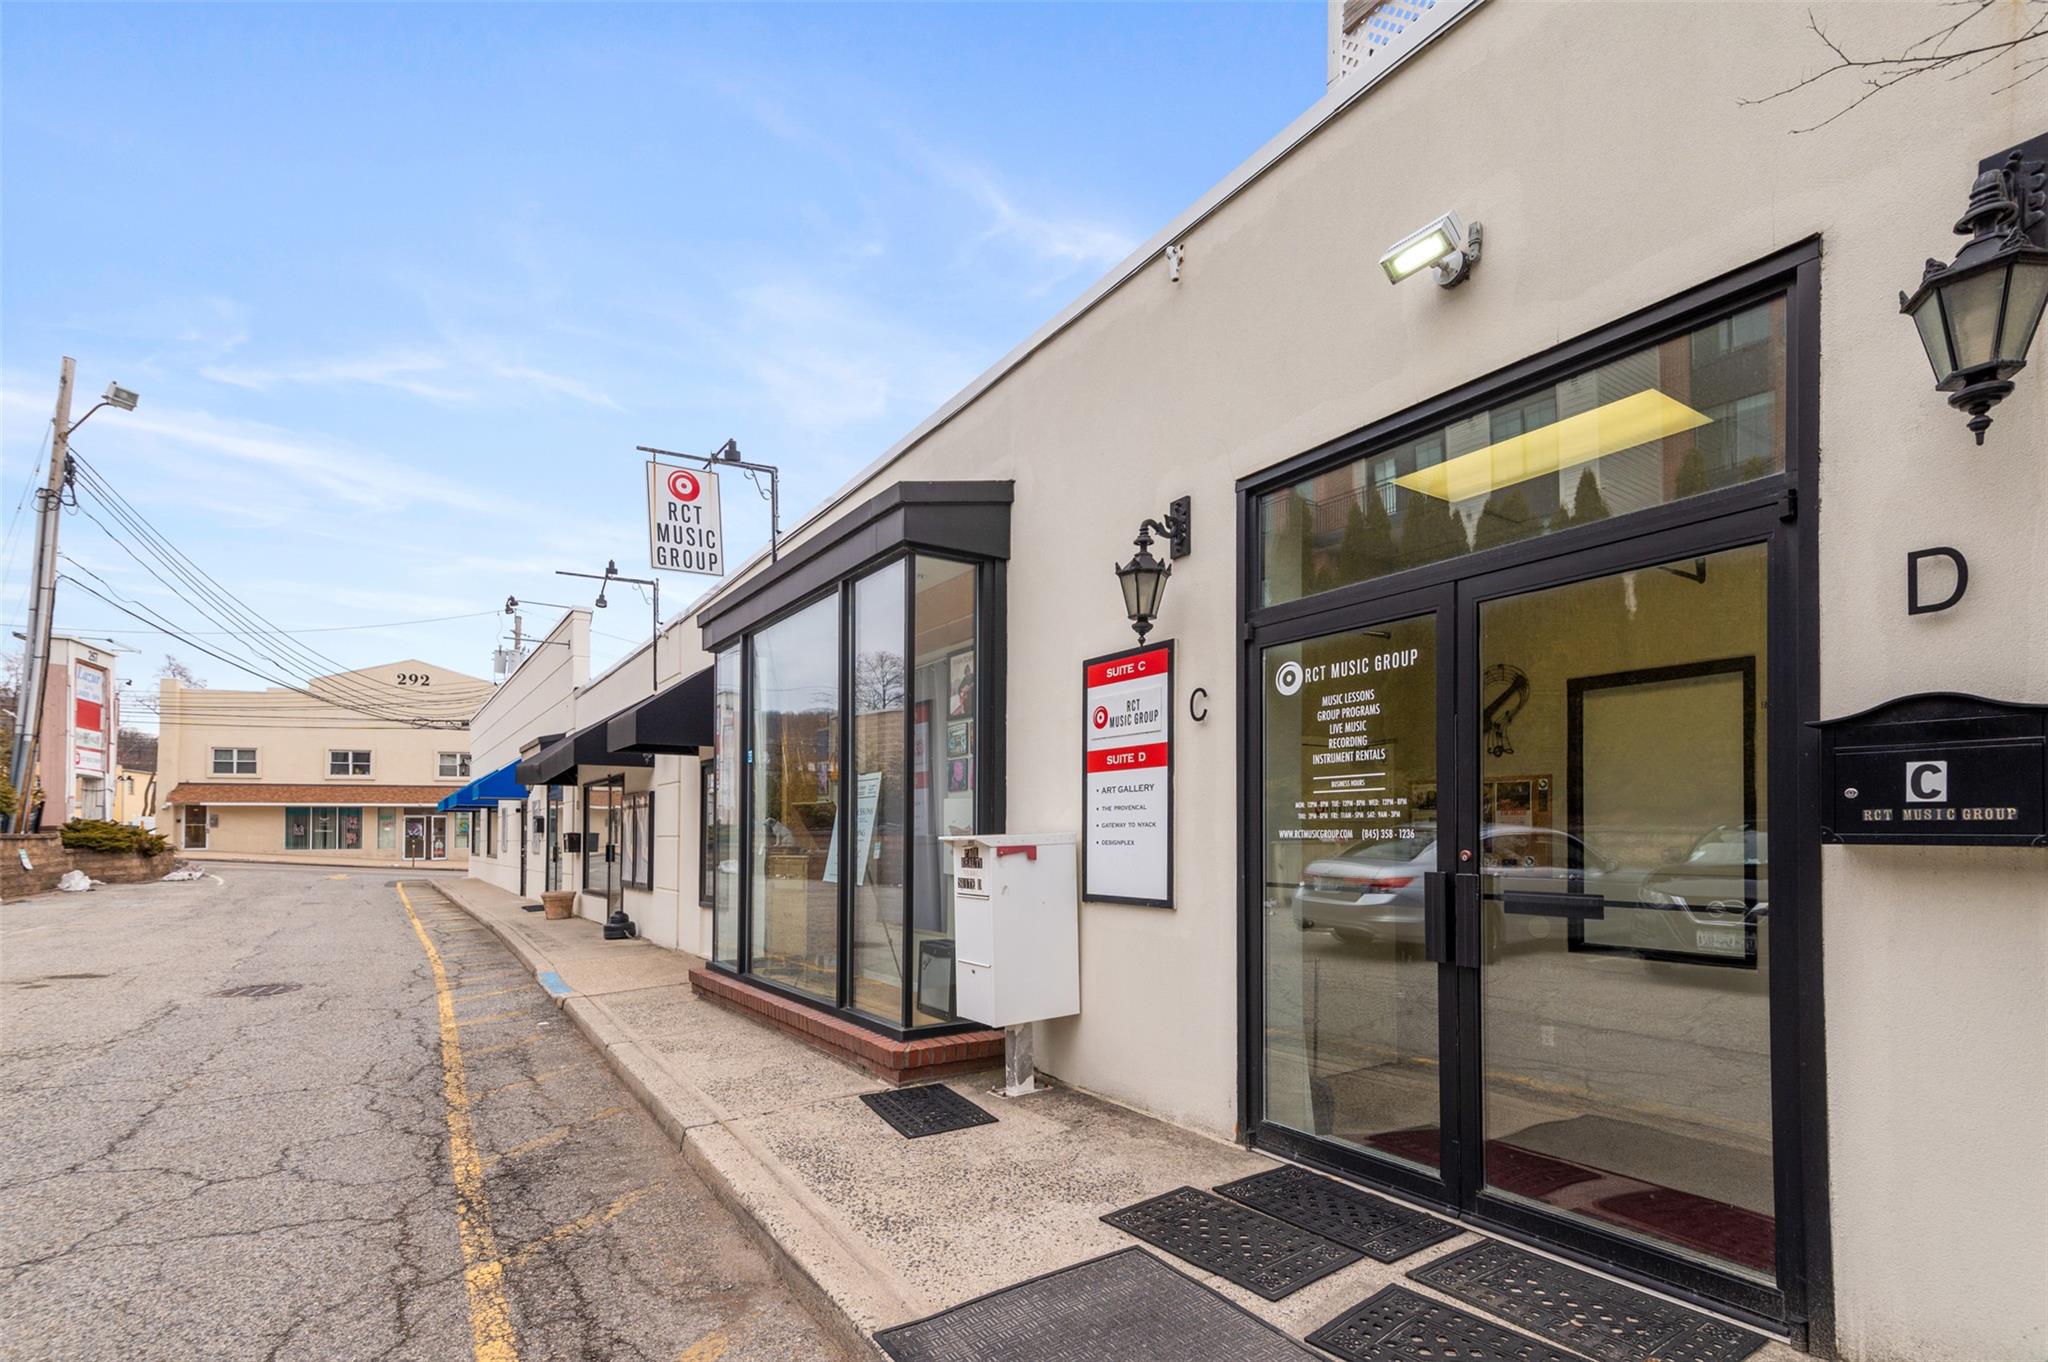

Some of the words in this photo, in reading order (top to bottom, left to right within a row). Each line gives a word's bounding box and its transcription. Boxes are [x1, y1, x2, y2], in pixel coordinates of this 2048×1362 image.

[668, 502, 702, 525] RCT
[657, 522, 716, 549] MUSIC
[657, 546, 718, 572] GROUP
[1907, 546, 1969, 616] D
[1106, 664, 1135, 678] SUITE
[1138, 661, 1146, 672] C
[1304, 665, 1326, 683] RCT
[1331, 659, 1369, 679] MUSIC
[1375, 649, 1418, 672] GROUP
[397, 673, 430, 686] 292
[1126, 699, 1141, 713] RCT
[1189, 687, 1208, 722] C
[1322, 693, 1343, 707] MUSIC
[1344, 689, 1375, 704] LESSONS
[1109, 713, 1132, 729] MUSIC
[1134, 709, 1159, 725] GROUP
[1317, 707, 1340, 721] GROUP
[1341, 703, 1380, 719] PROGRAMS
[1329, 722, 1343, 734] LIVE
[1344, 720, 1367, 733] MUSIC
[1328, 735, 1368, 749] RECORDING
[1106, 753, 1135, 765] SUITE
[1138, 752, 1146, 762] D
[1312, 751, 1354, 765] INSTRUMENT
[1355, 748, 1386, 762] RENTALS
[1101, 786, 1117, 794] ART
[1118, 784, 1155, 794] GALLERY
[1331, 780, 1351, 788] BUSINESS
[1351, 779, 1365, 787] HOURS
[1910, 763, 1942, 800] C
[1863, 809, 1893, 821] RCT
[1903, 809, 1955, 821] MUSIC
[1962, 808, 2017, 820] GROUP
[1279, 829, 1354, 839] WWW.RCTMUSICGROUP.COM
[1361, 829, 1380, 840] (845)
[1380, 829, 1393, 839] 358
[1399, 828, 1415, 839] 1236
